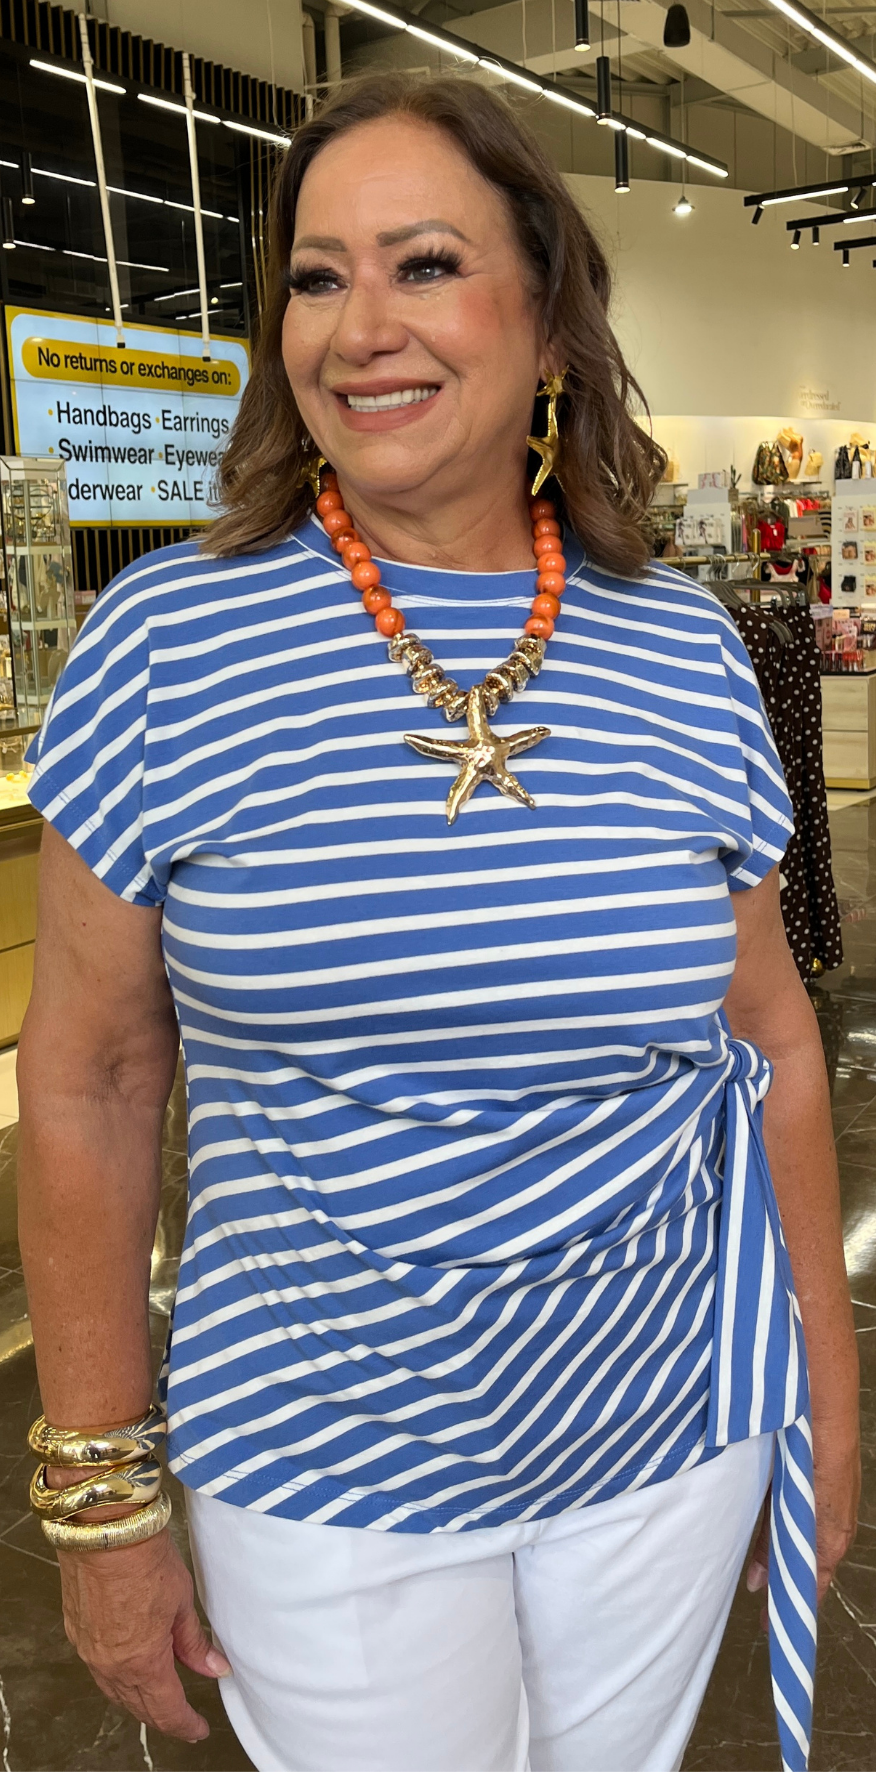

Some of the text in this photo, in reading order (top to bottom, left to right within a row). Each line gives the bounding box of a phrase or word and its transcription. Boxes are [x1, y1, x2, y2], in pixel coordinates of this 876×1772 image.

[38, 346, 232, 386] No returns or exchanges on:
[56, 400, 229, 438] Handbags Earrings
[58, 438, 223, 471] Swimwear Eyewe
[68, 477, 143, 501] derwear
[157, 479, 204, 501] SALE
